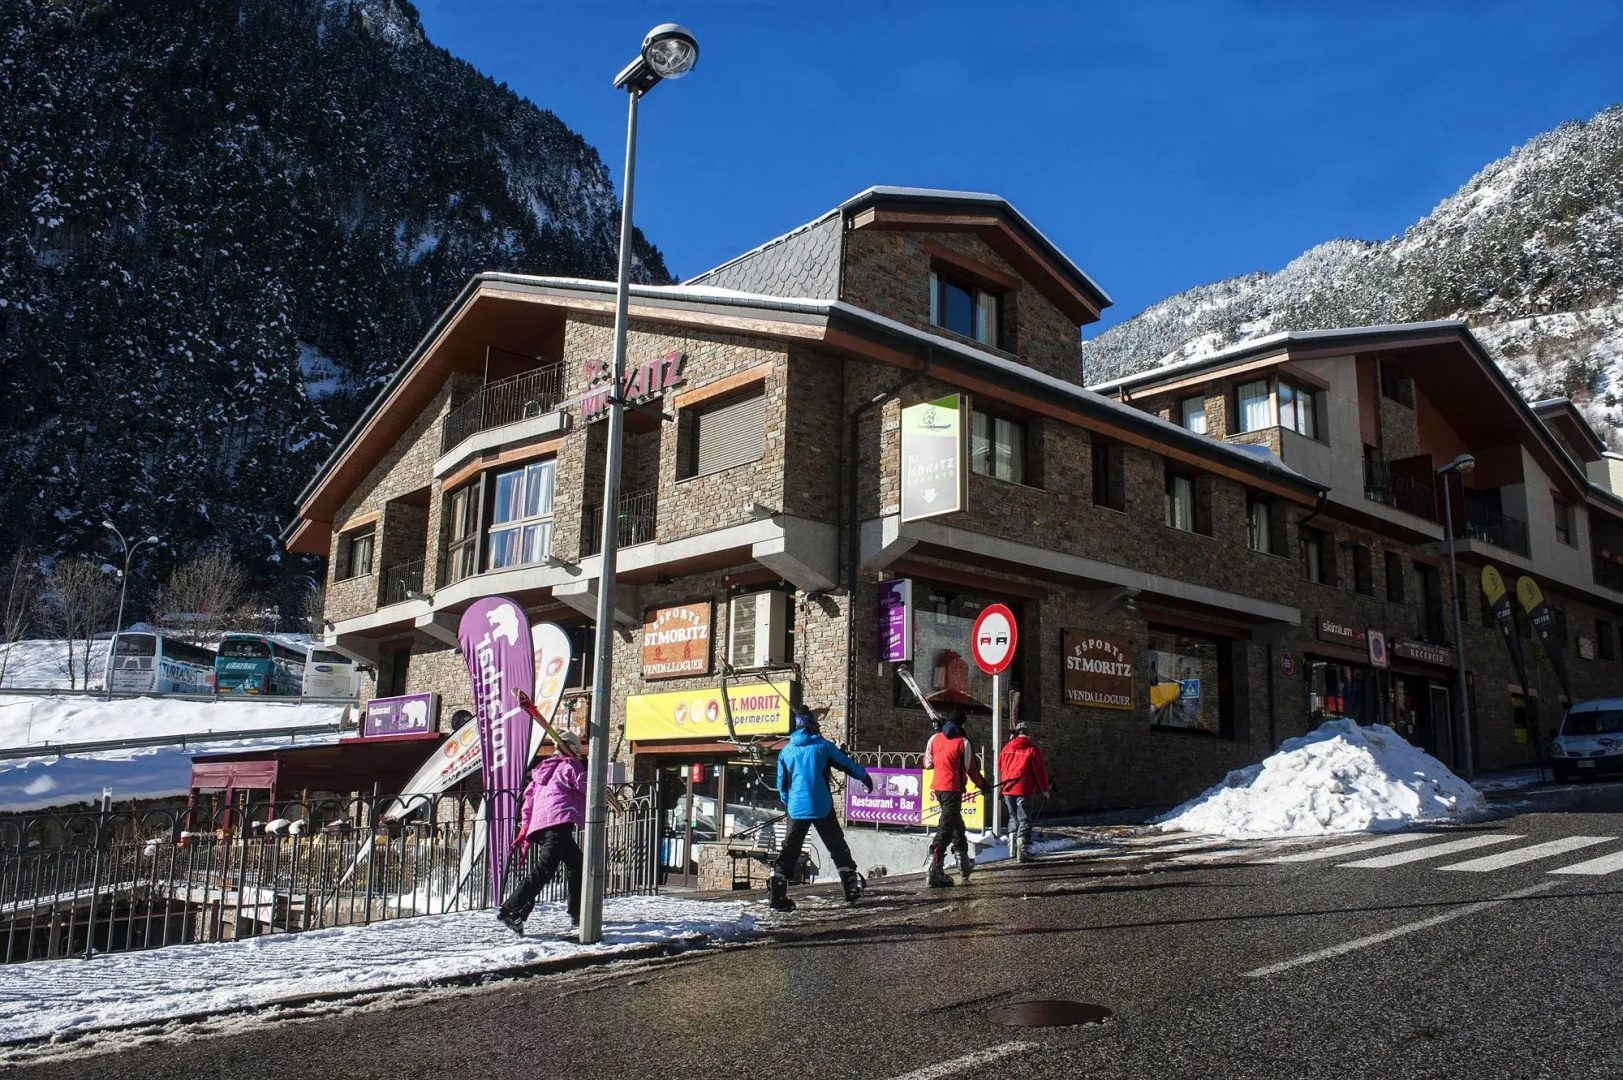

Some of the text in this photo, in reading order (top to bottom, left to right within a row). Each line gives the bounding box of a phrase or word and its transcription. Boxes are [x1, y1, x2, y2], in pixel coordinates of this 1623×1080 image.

[581, 352, 684, 420] MRITZ
[652, 608, 700, 631] ESPORTS
[1074, 639, 1124, 662] ESPORTS
[741, 695, 780, 711] MORITZ
[851, 795, 894, 809] Restaurant
[900, 798, 915, 810] Bar
